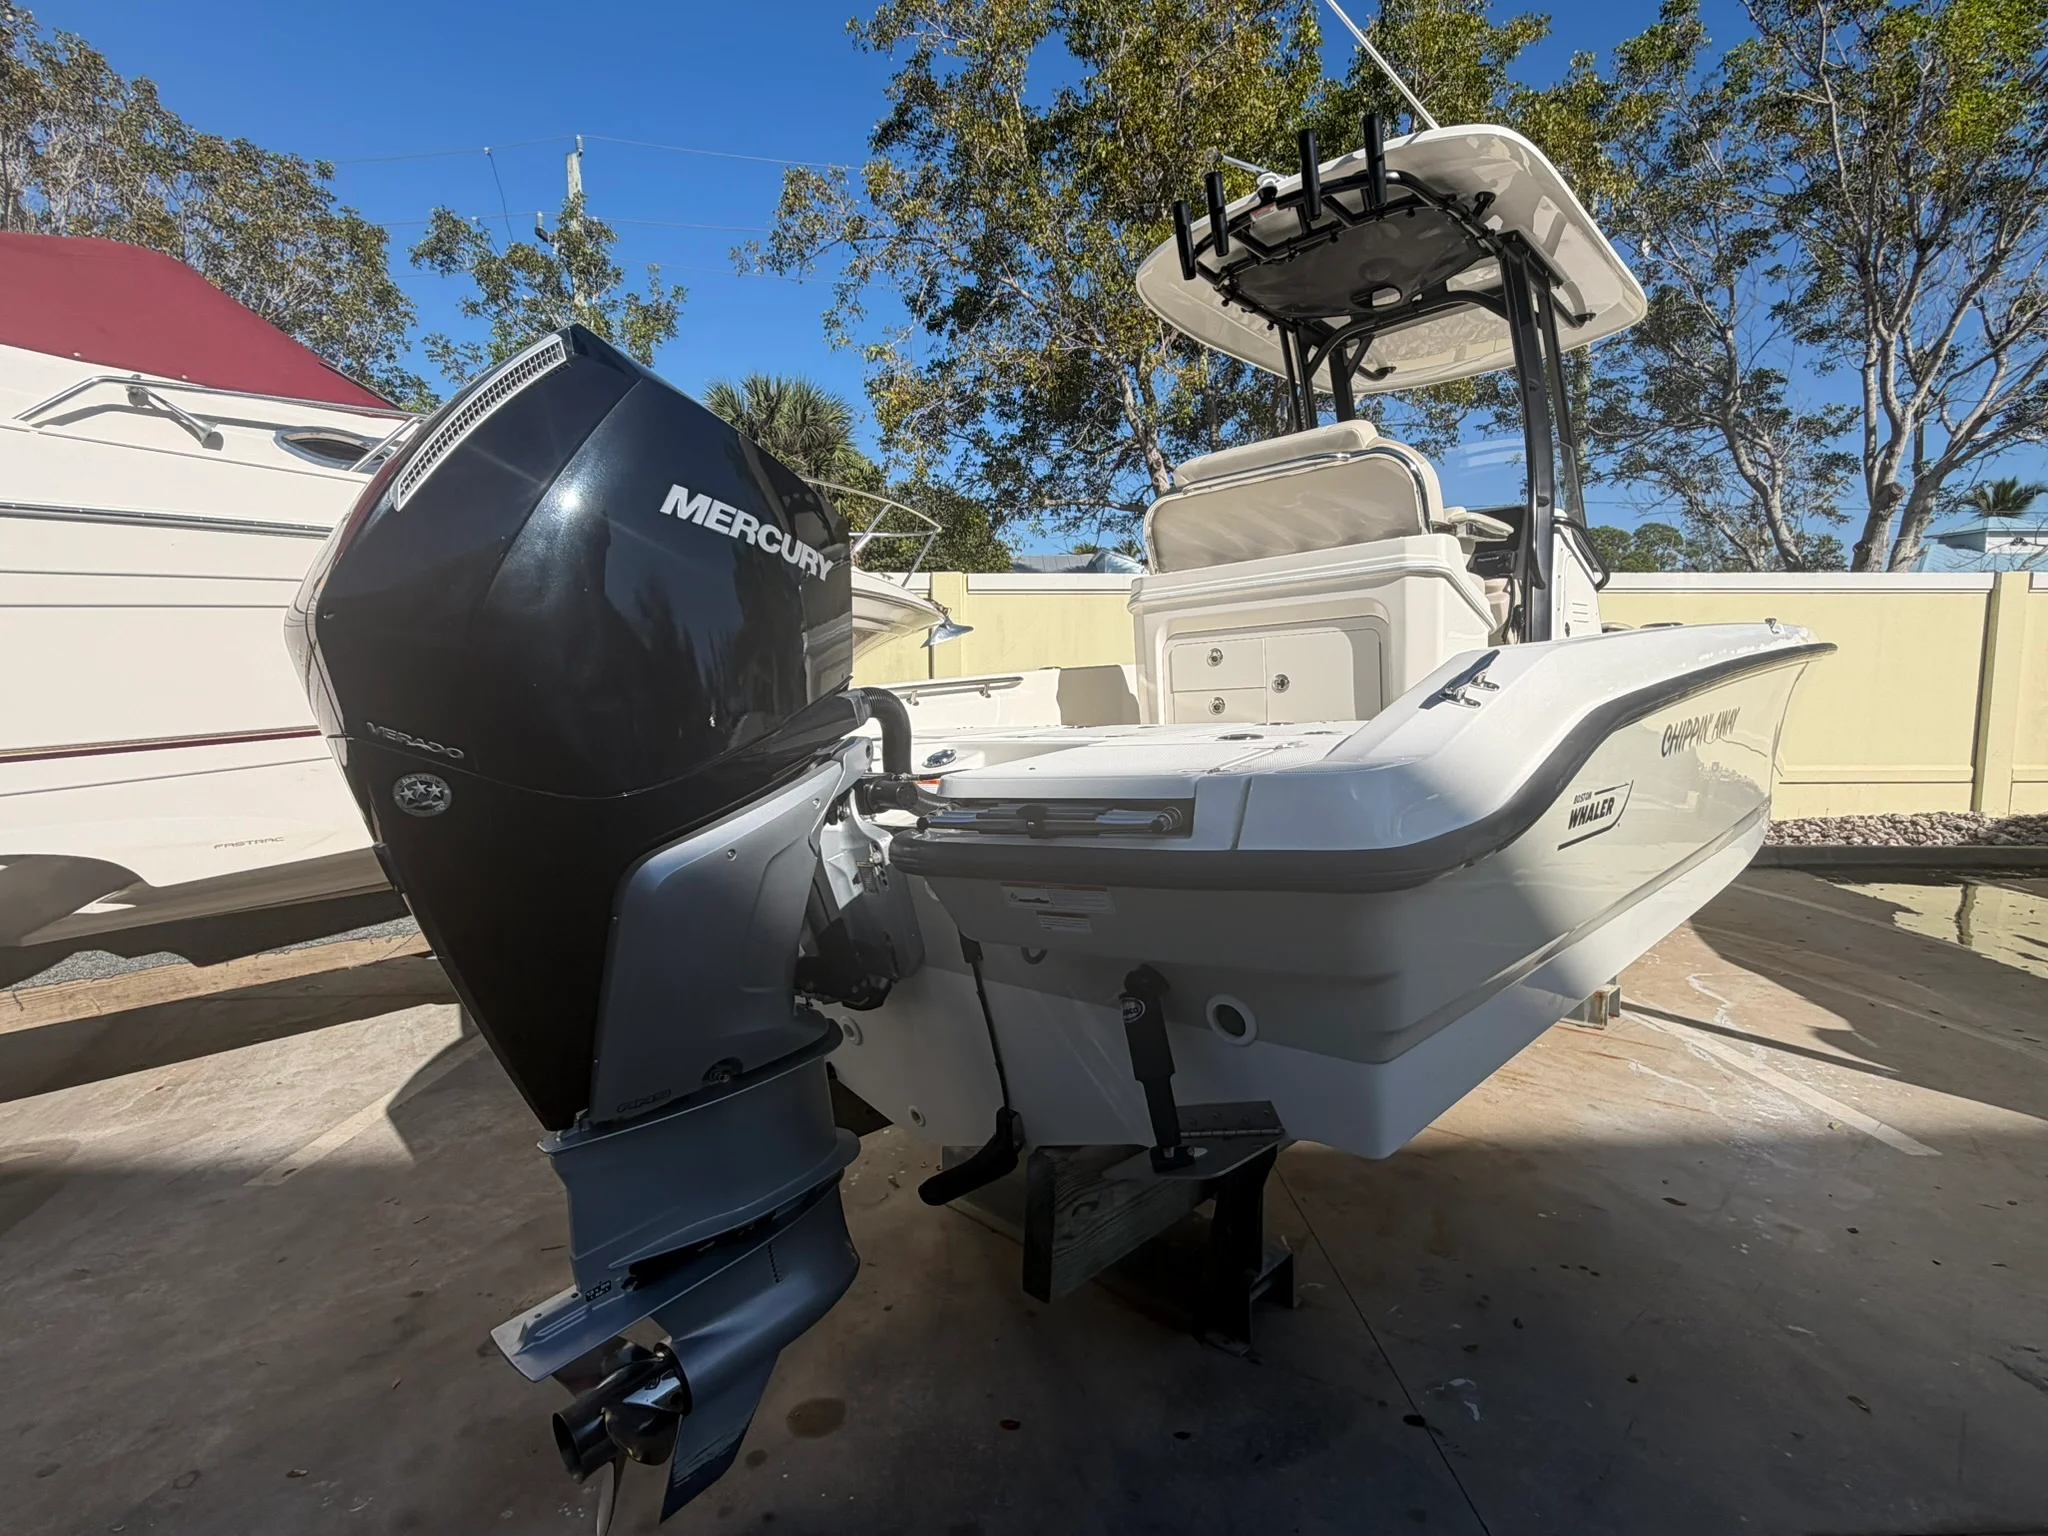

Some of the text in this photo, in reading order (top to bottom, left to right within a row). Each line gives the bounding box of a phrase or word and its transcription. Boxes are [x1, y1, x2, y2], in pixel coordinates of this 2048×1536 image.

[659, 483, 834, 582] MERCURY
[366, 721, 464, 759] VERADO
[1711, 706, 1740, 740] AWAY
[1568, 796, 1615, 831] WHALER
[1573, 791, 1592, 805] BOSTON
